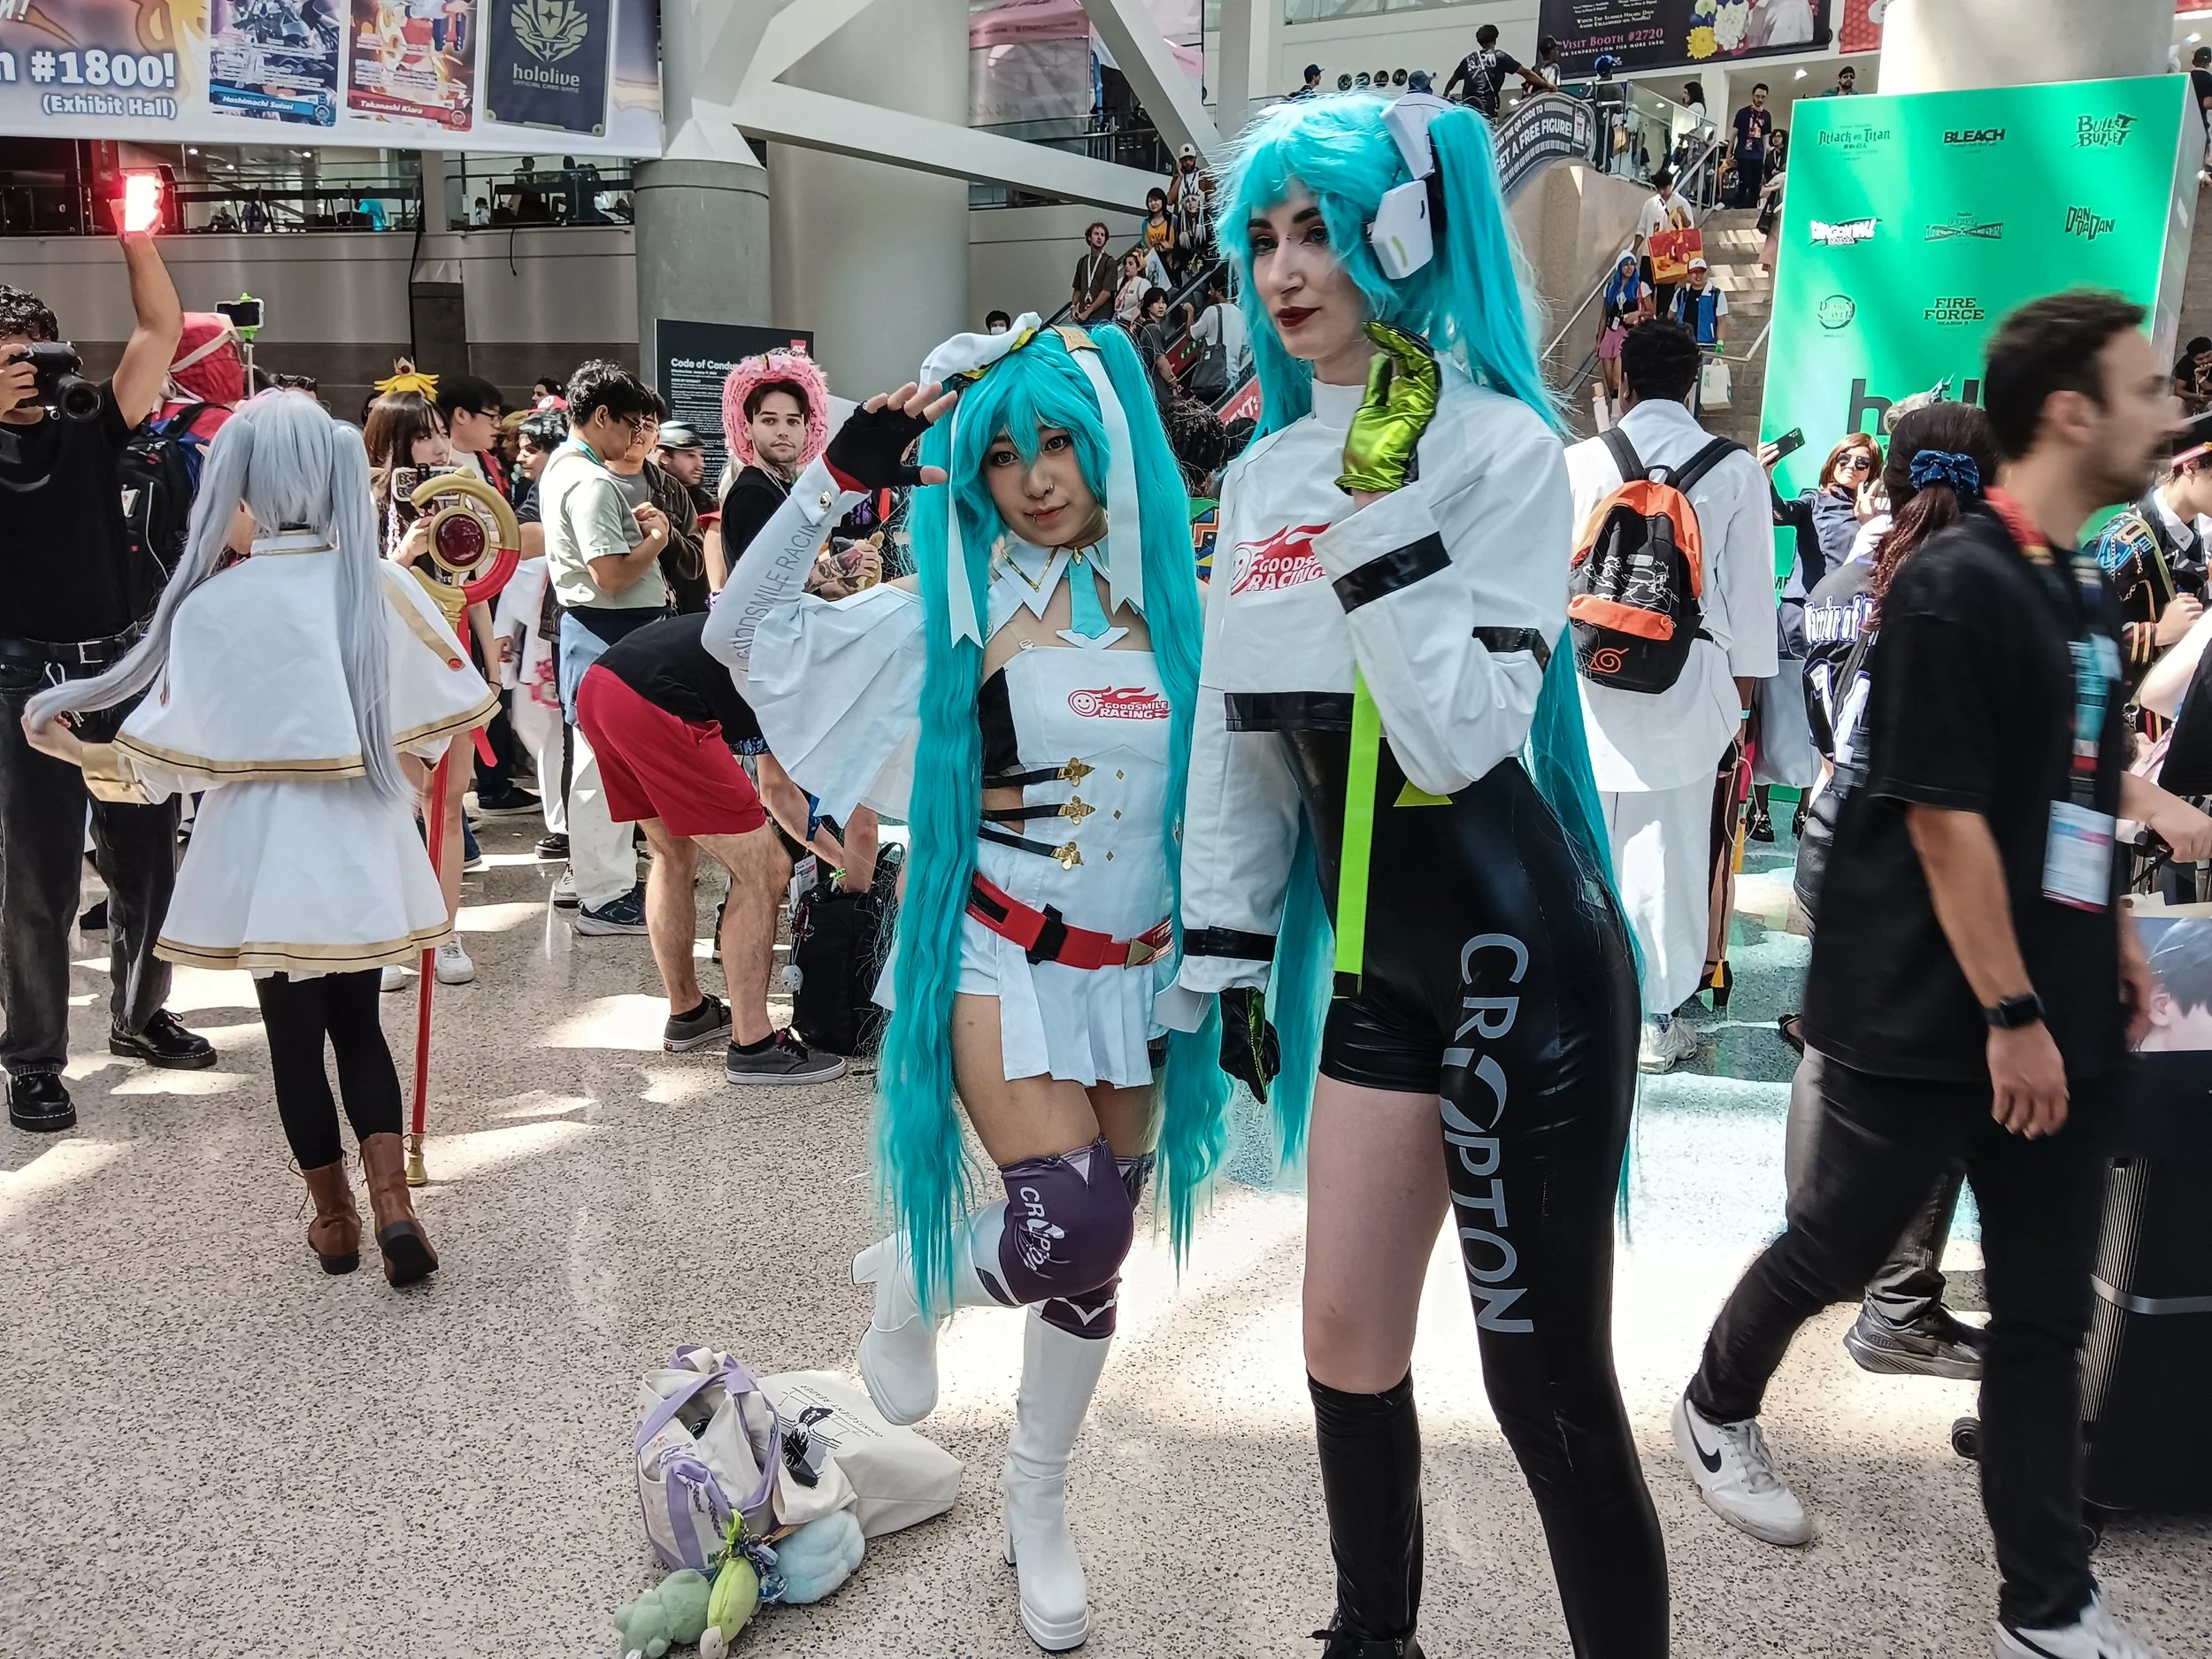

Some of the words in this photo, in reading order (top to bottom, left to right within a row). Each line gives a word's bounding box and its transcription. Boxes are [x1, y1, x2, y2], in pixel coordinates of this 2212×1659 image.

[1562, 39, 1587, 50] VISIT
[1590, 34, 1624, 47] BOOTH
[1628, 27, 1663, 42] #2720
[31, 50, 175, 88] #1800!
[513, 63, 580, 87] hololive
[43, 95, 123, 115] (Exhibit
[128, 98, 176, 119] Hall)
[222, 95, 269, 107] Hoshimachi
[360, 100, 401, 111] Takanashi
[402, 105, 423, 114] Kiara
[1536, 104, 1543, 115] TO
[1512, 142, 1519, 158] A
[1518, 121, 1540, 150] FREE
[1541, 118, 1572, 137] FIGURE!
[1818, 131, 1851, 146] Attack
[1864, 128, 1890, 142] Titan
[1944, 128, 2006, 143] BLEACH
[1935, 297, 1977, 308] FIRE
[1924, 309, 1985, 320] FORCE
[671, 357, 695, 368] Code
[695, 359, 706, 369] of
[775, 522, 822, 571] RACIN
[1247, 566, 1323, 591] RACING
[1100, 708, 1153, 718] RACING
[1104, 701, 1168, 710] GOODSMILE
